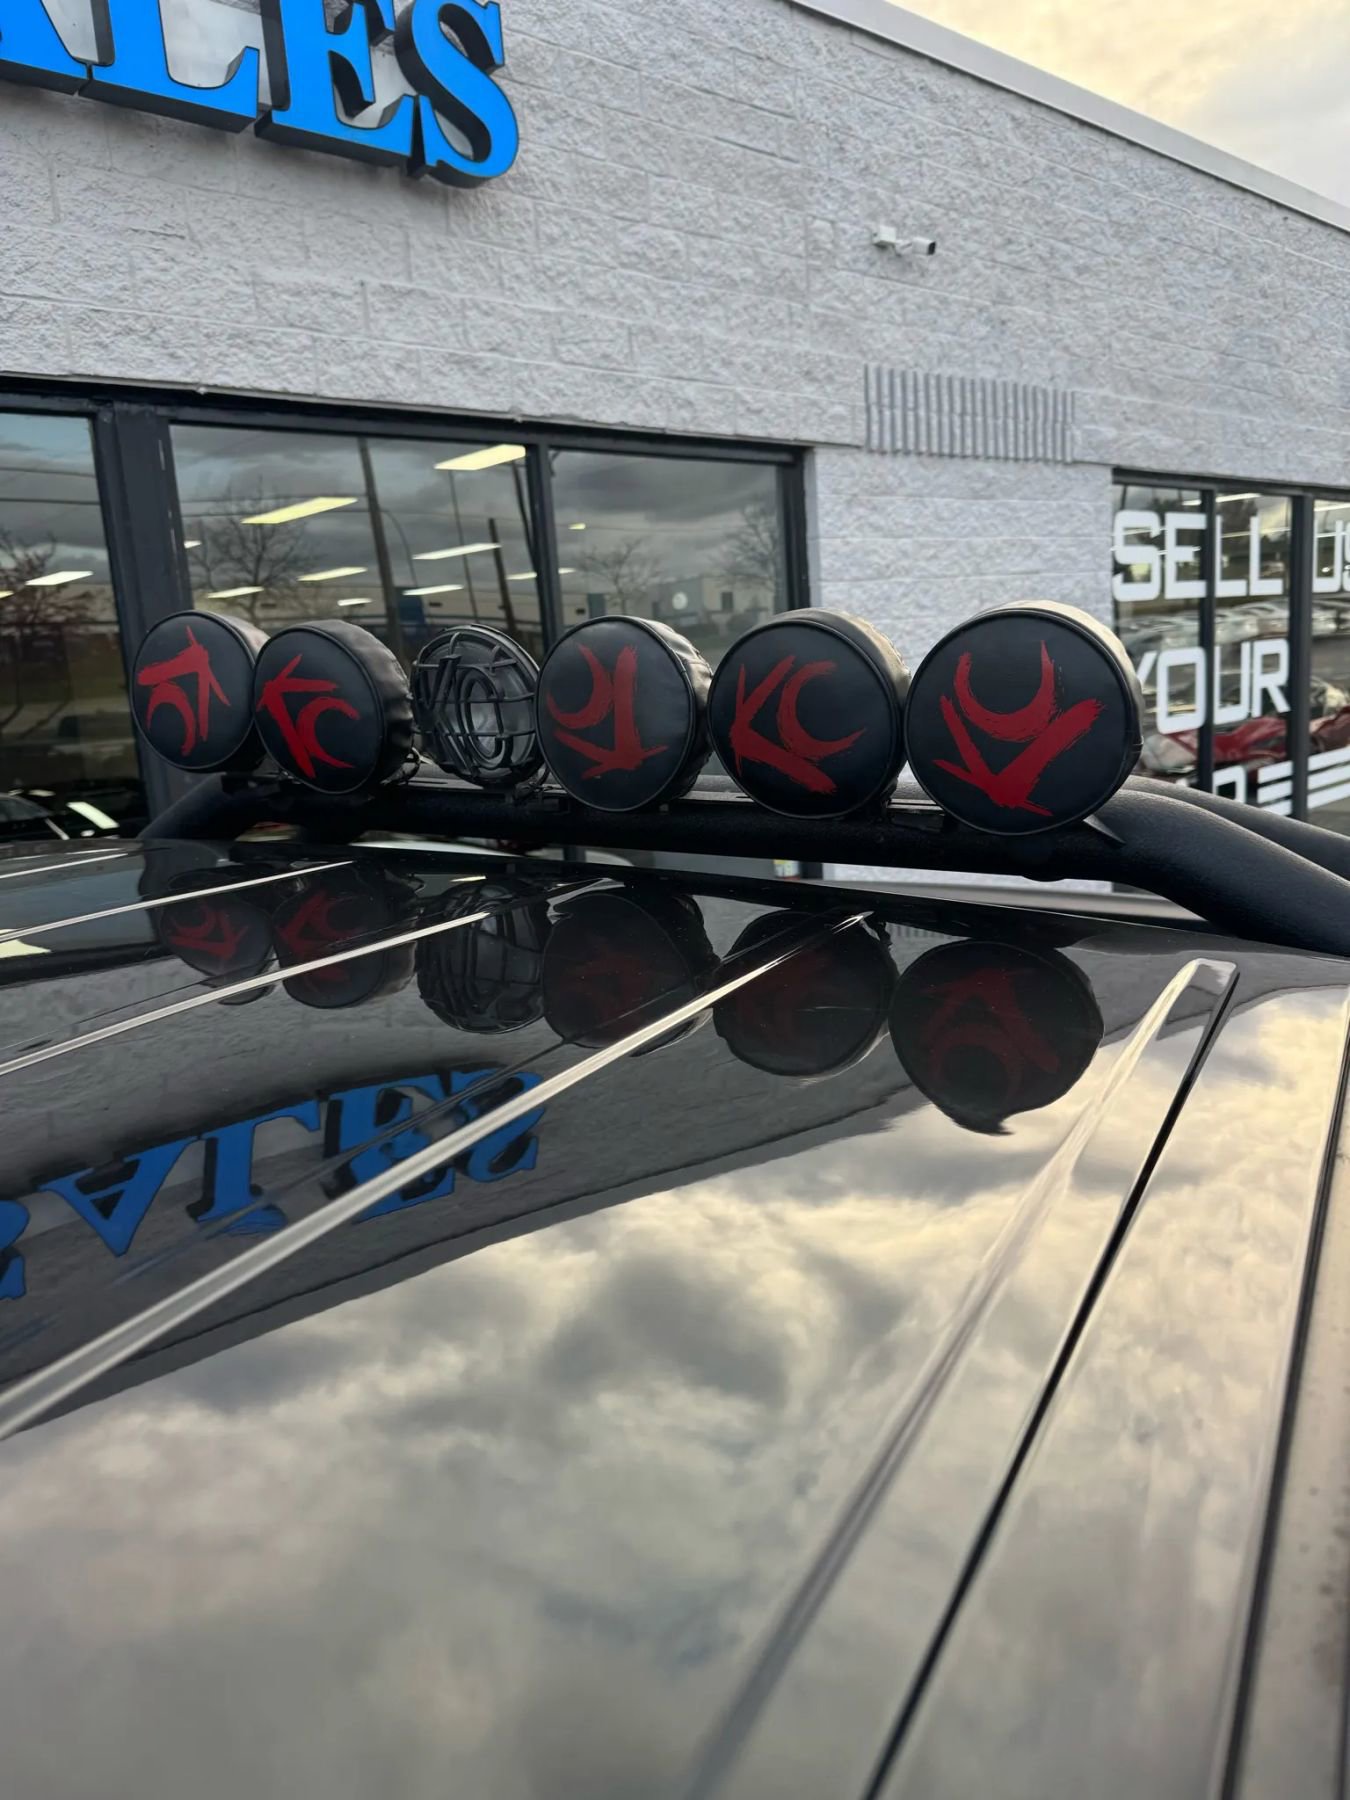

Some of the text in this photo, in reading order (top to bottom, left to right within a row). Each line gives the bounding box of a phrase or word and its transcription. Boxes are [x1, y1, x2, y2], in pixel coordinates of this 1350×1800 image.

[0, 0, 519, 184] LES
[1111, 509, 1350, 601] SELL U
[137, 625, 230, 756] KC
[256, 654, 361, 779] KC
[546, 644, 669, 780] KC
[730, 655, 867, 795] KC
[932, 639, 1105, 818] KC
